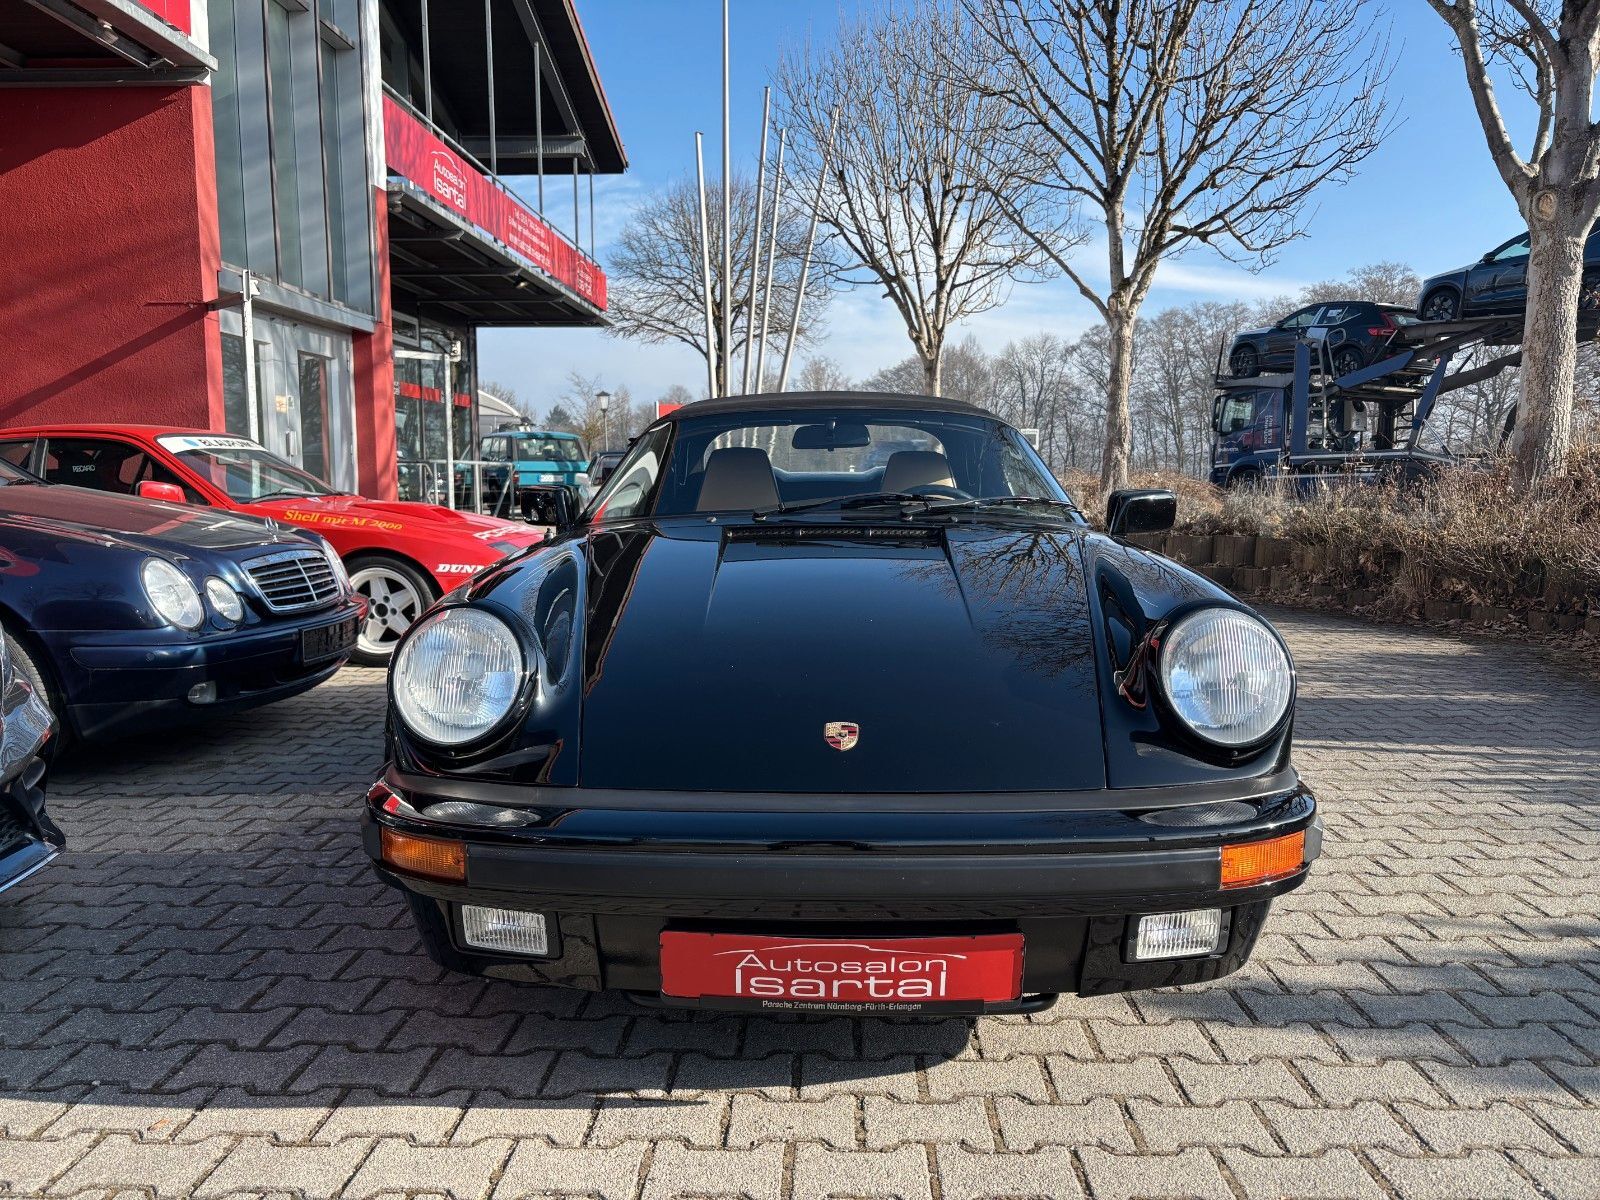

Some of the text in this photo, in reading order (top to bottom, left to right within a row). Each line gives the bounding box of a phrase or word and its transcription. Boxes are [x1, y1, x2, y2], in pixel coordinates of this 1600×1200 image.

[284, 509, 403, 530] Shell mit M 2000
[736, 953, 947, 974] Autosalon
[735, 968, 947, 998] Isartal
[762, 1000, 793, 1009] Porsche
[793, 1001, 826, 1010] Zentrum
